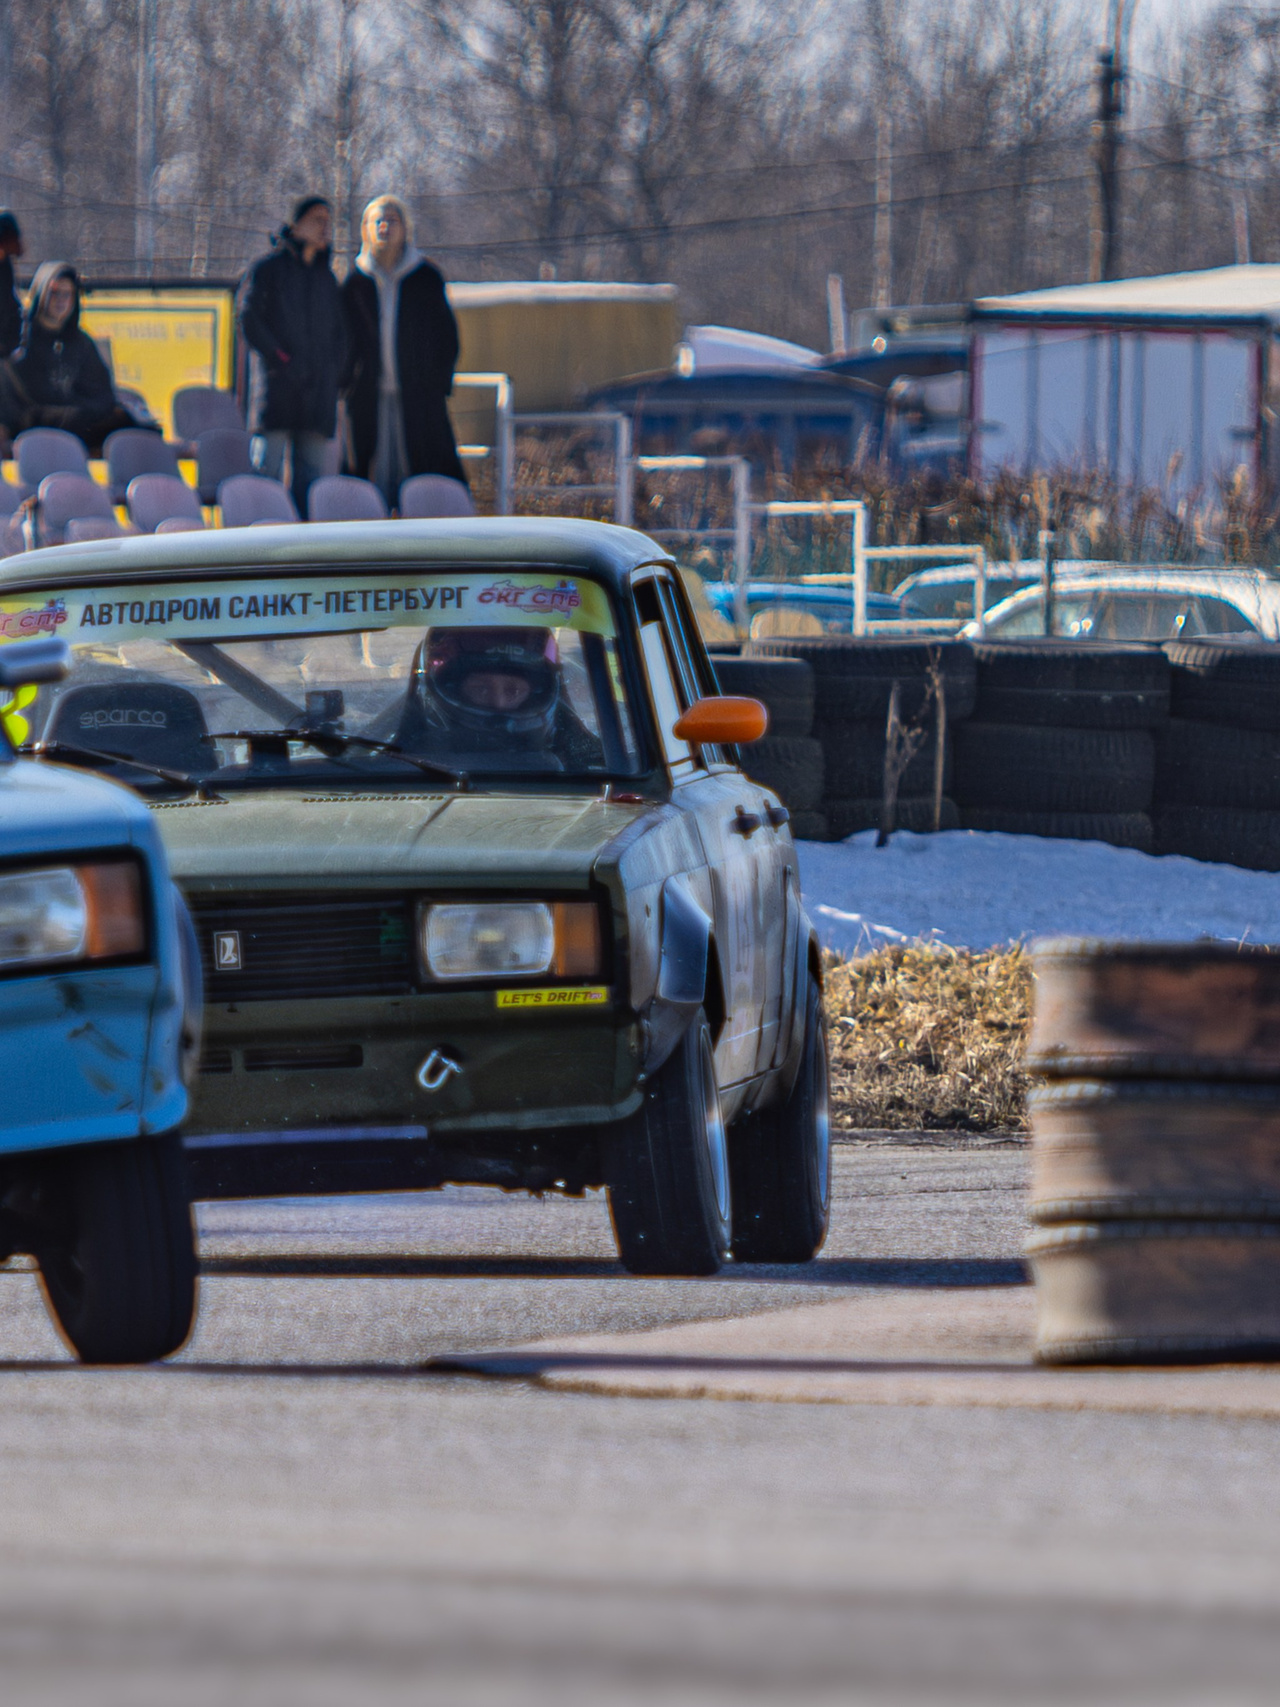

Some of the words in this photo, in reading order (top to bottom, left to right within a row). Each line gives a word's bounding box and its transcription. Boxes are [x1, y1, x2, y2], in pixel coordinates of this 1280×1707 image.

[80, 594, 222, 627] АВТОДРОМ
[228, 586, 469, 620] САНКТ-ПЕТЕРБУРГ
[531, 591, 581, 608] СПБ
[19, 610, 69, 628] СПБ
[79, 708, 167, 730] sparco
[502, 993, 543, 1005] LET'S
[547, 991, 592, 1003] DRIFT
